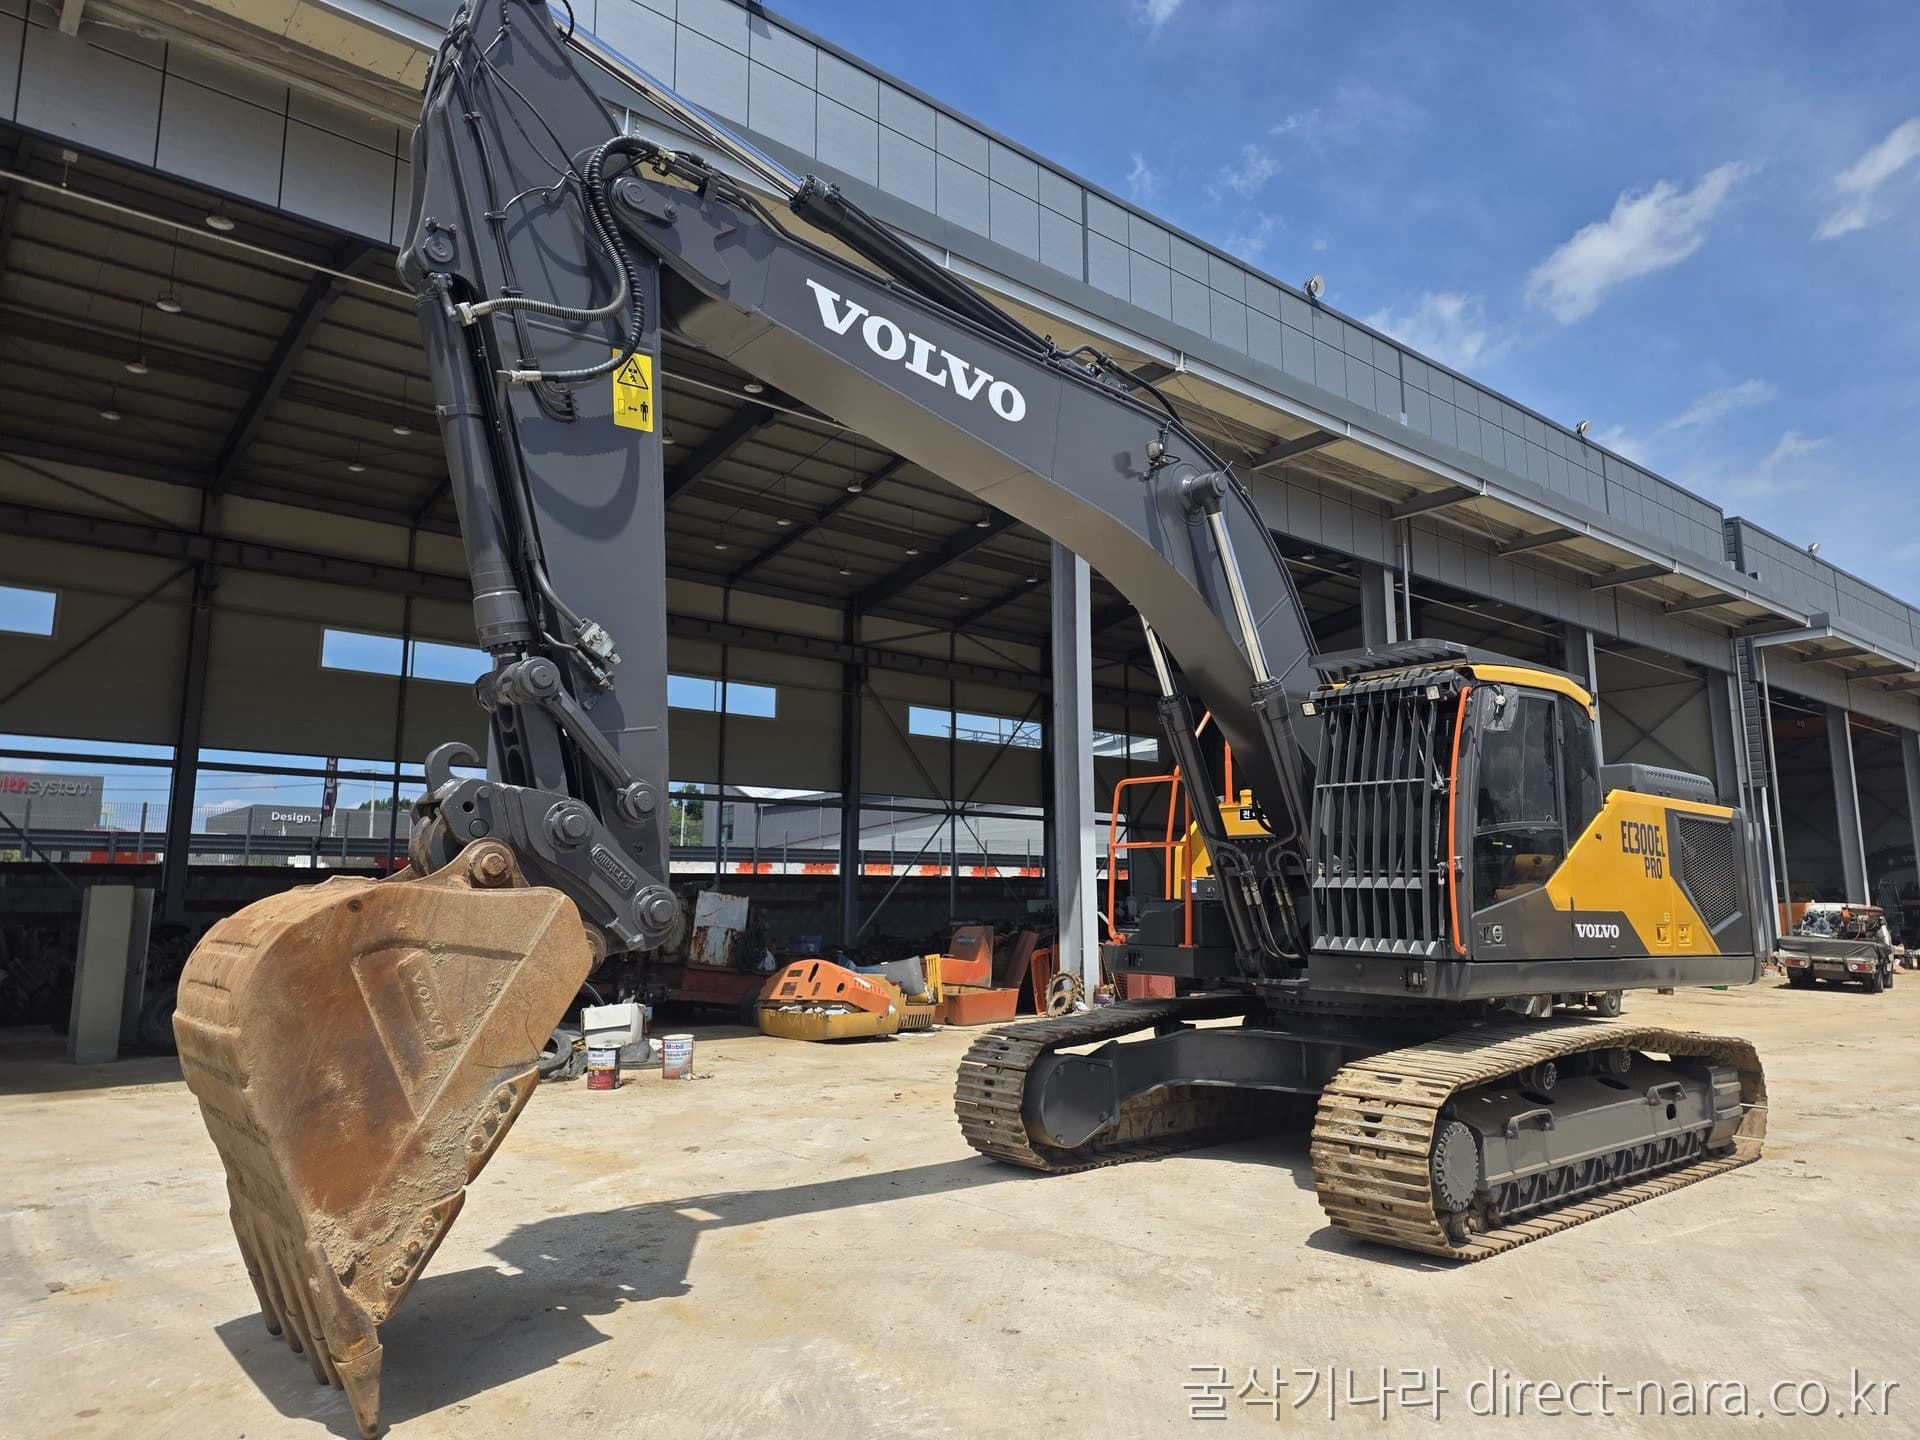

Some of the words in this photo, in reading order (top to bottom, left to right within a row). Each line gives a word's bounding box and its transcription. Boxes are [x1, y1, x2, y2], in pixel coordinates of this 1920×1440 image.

[806, 278, 1026, 422] VOLVO
[1644, 856, 1663, 880] PRO
[1575, 923, 1620, 939] VOLVO
[412, 969, 445, 1038] VOLVO
